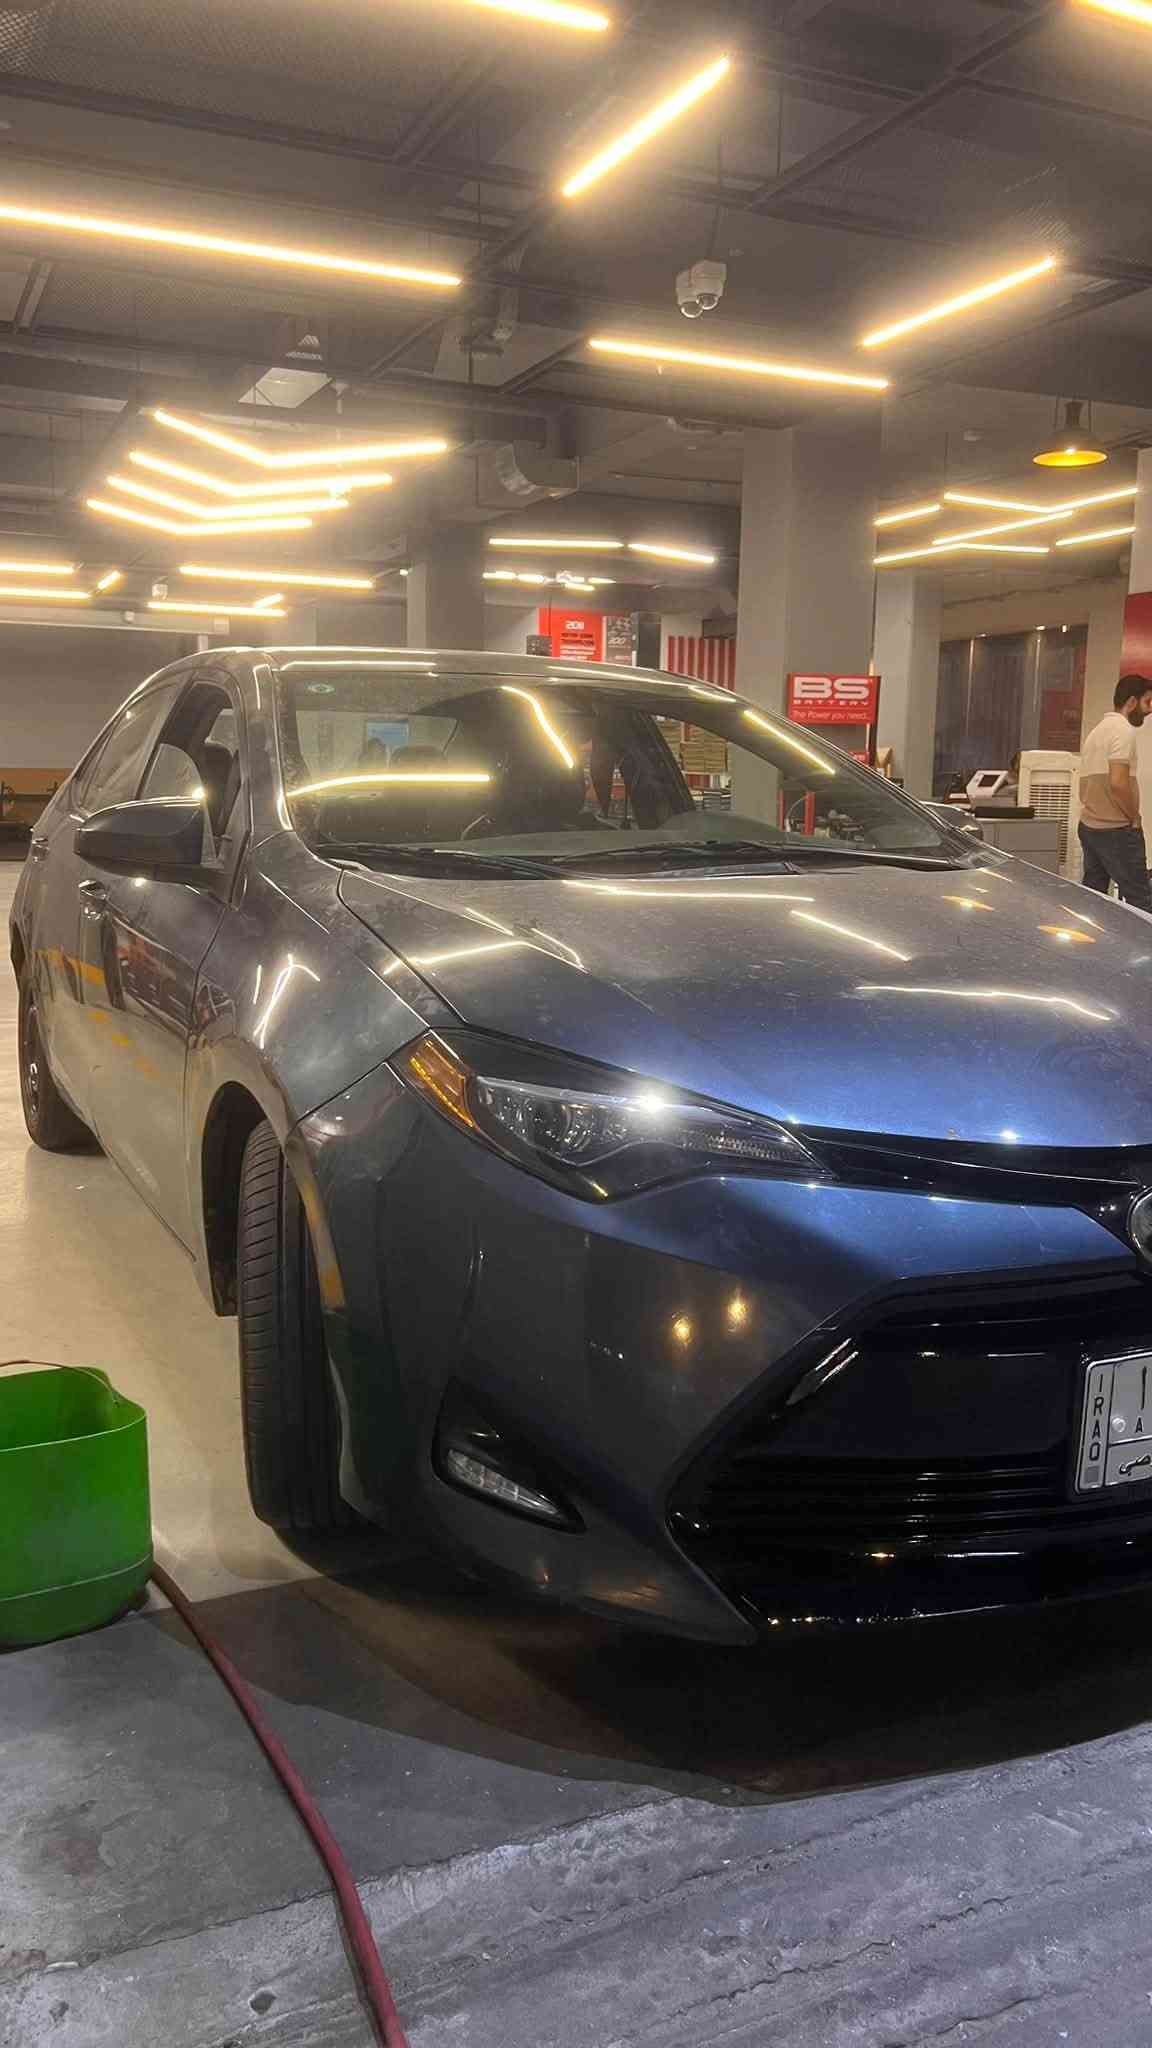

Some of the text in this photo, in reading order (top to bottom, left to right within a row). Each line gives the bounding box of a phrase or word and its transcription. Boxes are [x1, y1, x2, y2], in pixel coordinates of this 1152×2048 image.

[793, 676, 870, 700] BS
[807, 711, 830, 719] Power
[831, 713, 846, 721] you
[1135, 1416, 1144, 1434] A
